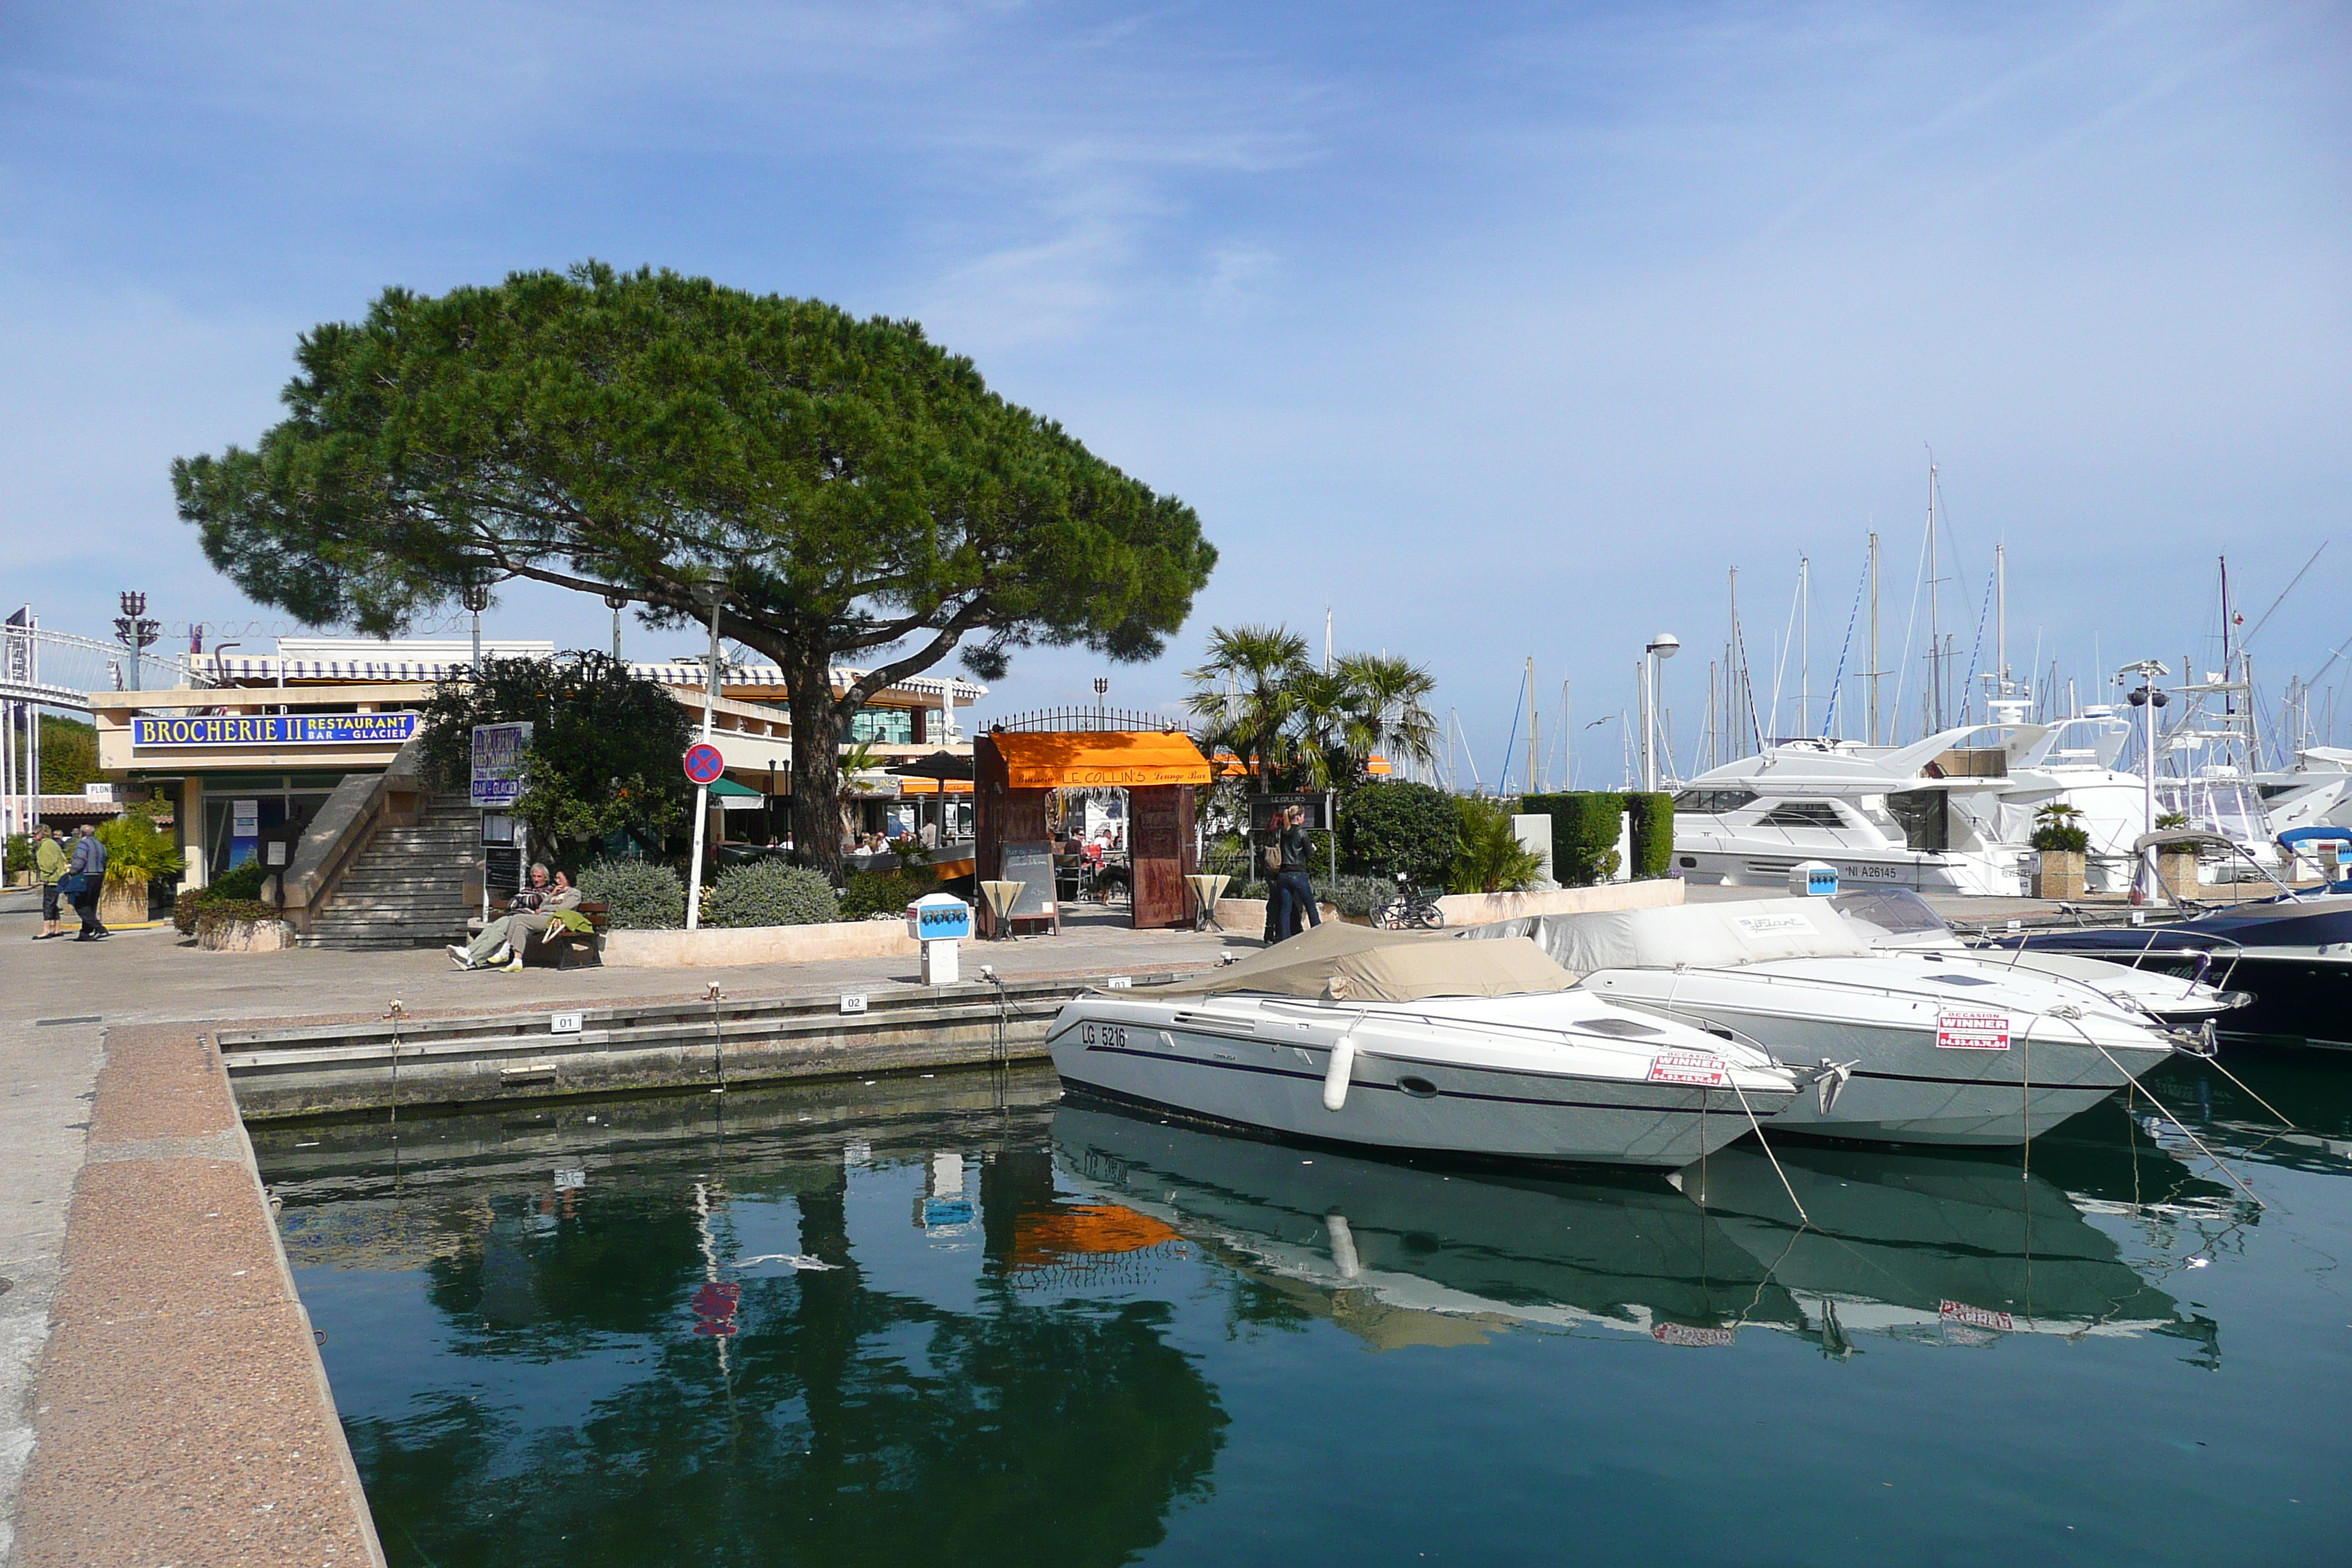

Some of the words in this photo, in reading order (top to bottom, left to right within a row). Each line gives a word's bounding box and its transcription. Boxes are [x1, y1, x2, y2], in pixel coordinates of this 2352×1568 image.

[141, 719, 278, 742] BROCHERIE
[285, 718, 302, 741] II
[308, 717, 407, 730] RESTAURANT
[308, 731, 333, 740] BAR
[353, 729, 407, 739] GLACIER
[475, 753, 518, 766] RESTAURAN
[1015, 774, 1055, 784] Brasserie
[1062, 772, 1082, 785] LE
[1085, 769, 1146, 783] COLLIN'S
[1153, 772, 1185, 782] Lounge
[1187, 771, 1207, 780] Bar
[474, 783, 486, 794] BAR
[1861, 866, 1896, 878] A26145
[848, 998, 860, 1008] 02
[559, 1018, 572, 1028] 01
[1941, 1018, 2007, 1029] WINNER
[1082, 1025, 1096, 1045] LG
[1101, 1026, 1126, 1048] 5216
[1667, 1052, 1719, 1060] OCCASION
[1658, 1056, 1724, 1070] WINNER
